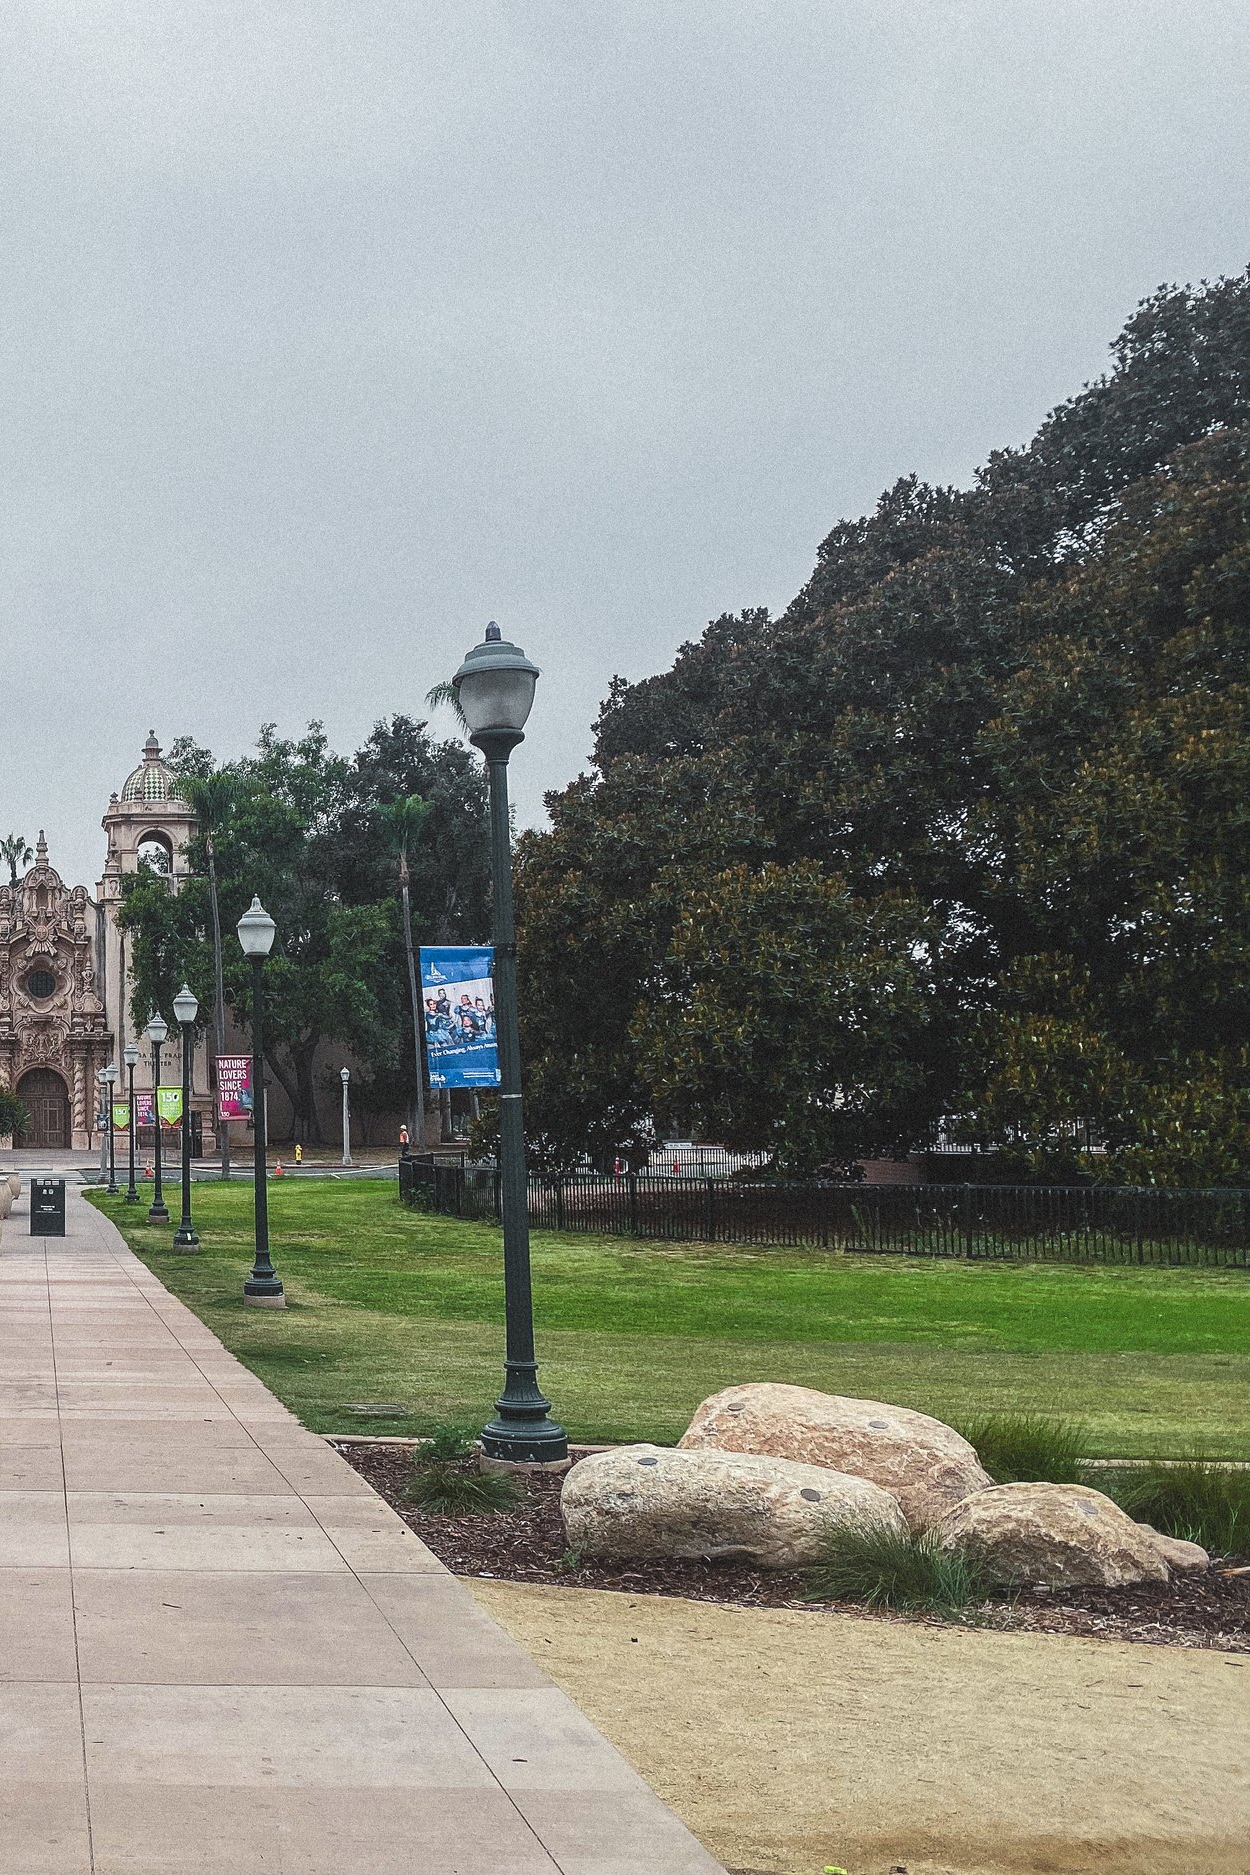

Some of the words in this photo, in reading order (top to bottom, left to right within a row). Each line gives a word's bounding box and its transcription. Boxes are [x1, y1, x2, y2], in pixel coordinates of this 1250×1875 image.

[218, 1059, 247, 1069] NATURE
[219, 1070, 247, 1080] LOVERS
[220, 1081, 242, 1091] SINCE
[162, 1092, 180, 1102] 150
[221, 1092, 241, 1102] 1874.
